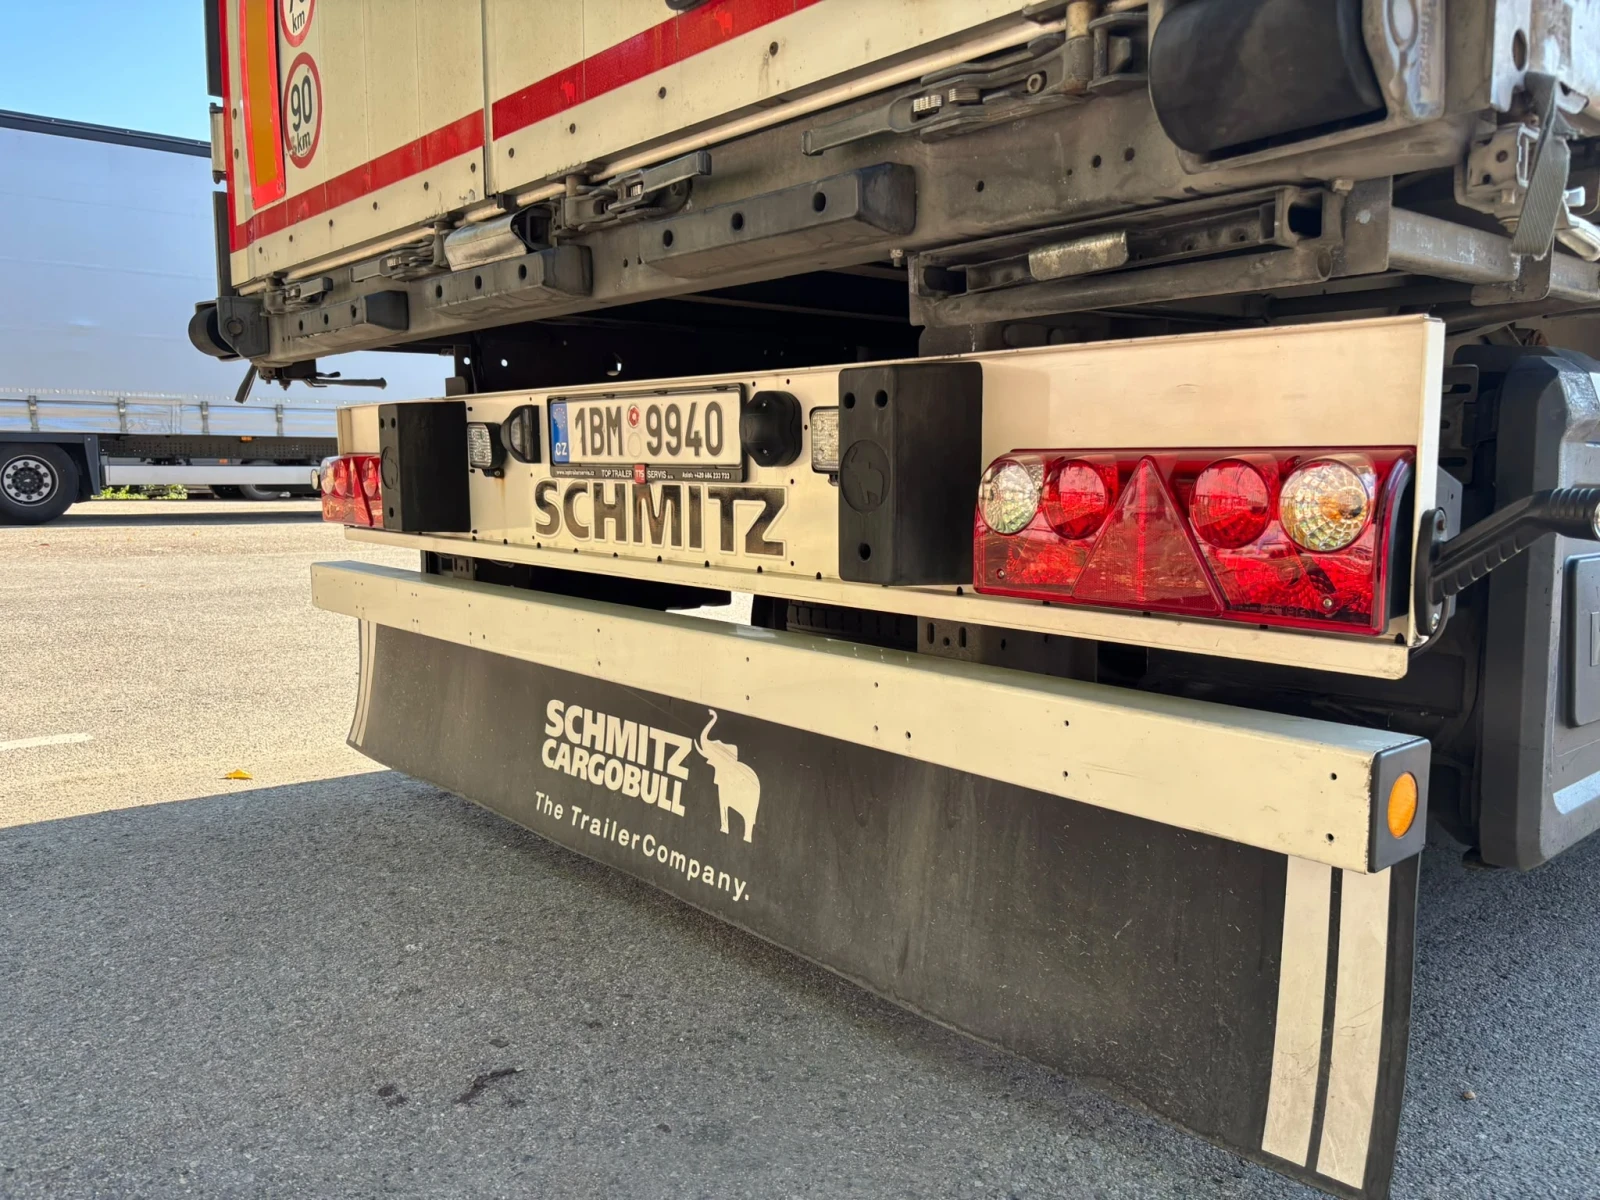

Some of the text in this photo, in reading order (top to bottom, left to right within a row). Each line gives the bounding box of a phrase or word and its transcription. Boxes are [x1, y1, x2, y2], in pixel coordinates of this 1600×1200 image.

[292, 10, 305, 33] km
[291, 75, 313, 132] 90
[297, 131, 311, 153] km
[555, 442, 568, 456] CZ
[575, 401, 723, 457] 1BM 9940
[601, 469, 611, 478] TOP
[612, 469, 633, 478] TRAILER
[647, 470, 667, 479] SERVIS
[534, 480, 786, 558] SCHMITZ
[545, 699, 692, 780] SCHMITZ
[541, 738, 686, 817] CARGOBULL
[535, 791, 564, 820] The
